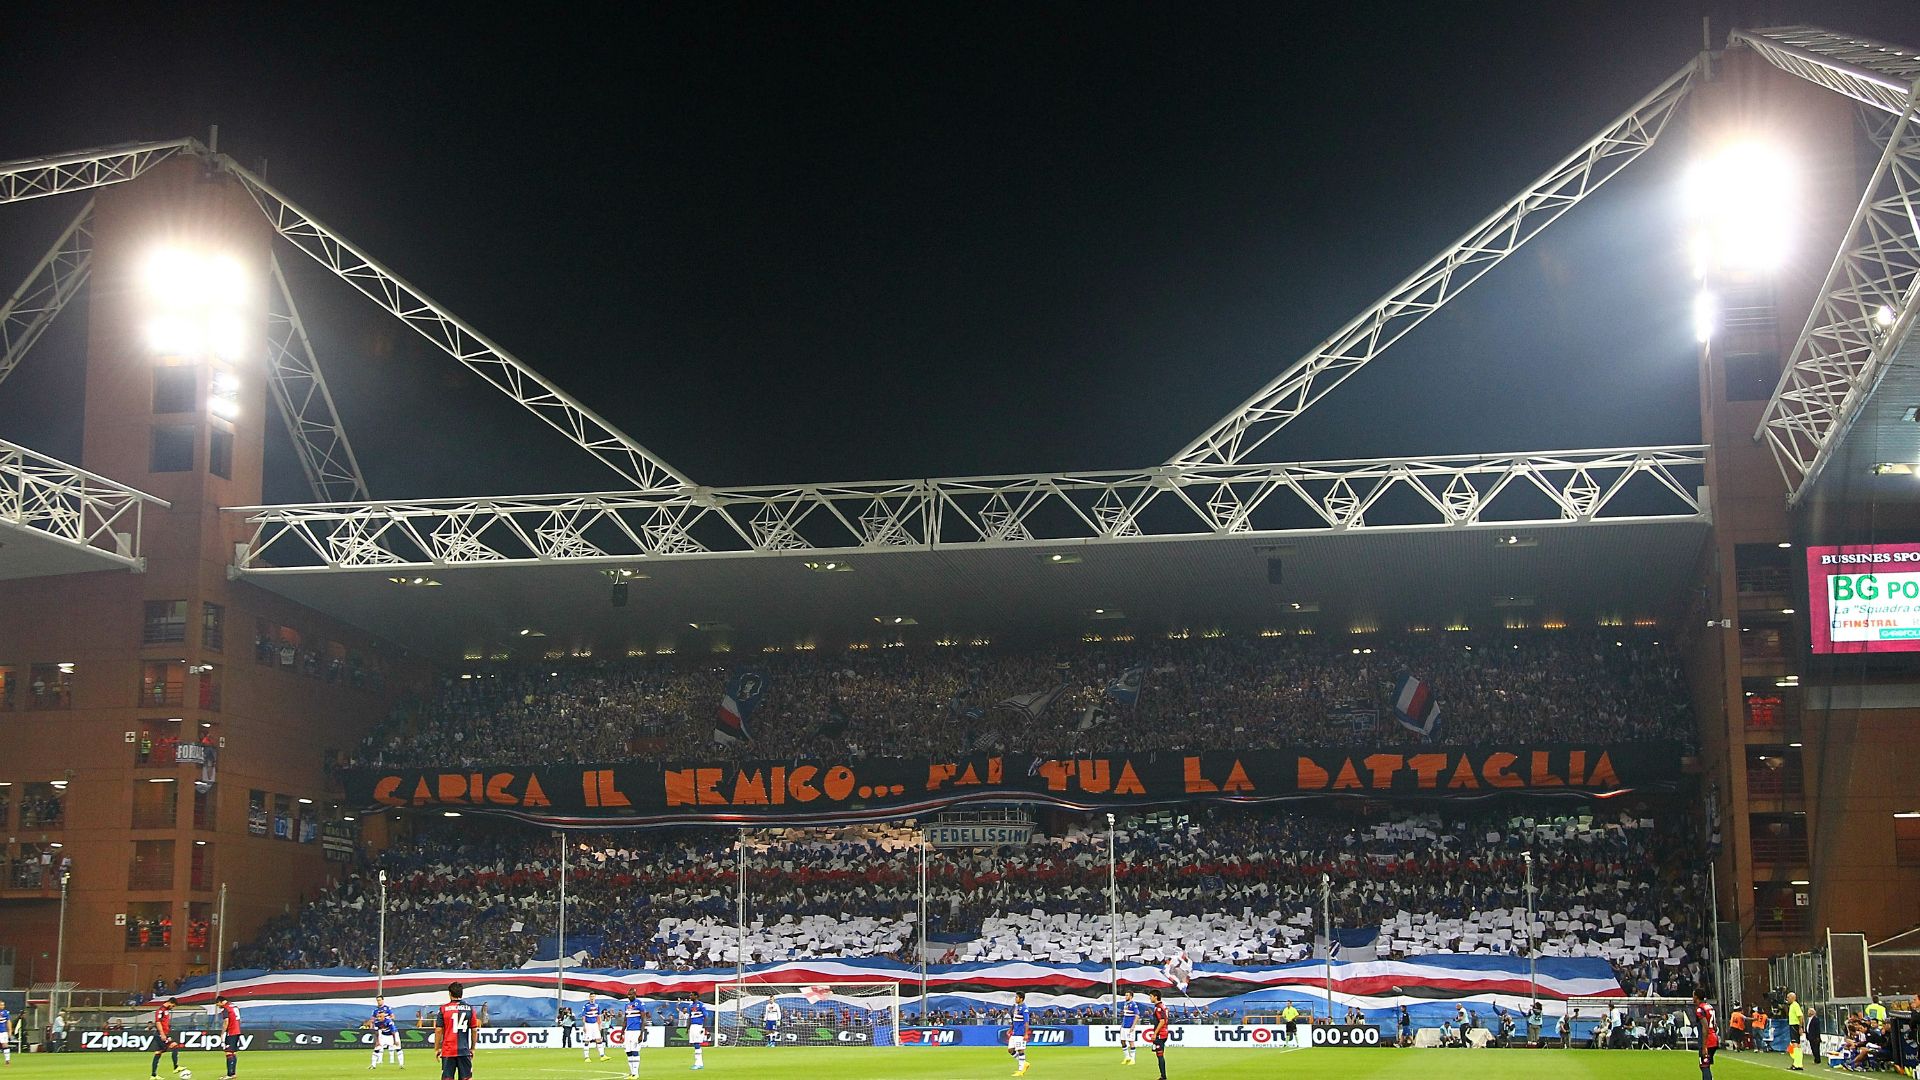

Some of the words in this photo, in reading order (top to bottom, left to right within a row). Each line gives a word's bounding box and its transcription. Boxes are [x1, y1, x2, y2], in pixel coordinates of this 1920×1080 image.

[1821, 553, 1891, 564] BUSSINES
[1833, 574, 1879, 601] BG
[1887, 581, 1919, 599] PO
[1843, 619, 1899, 628] FINSTRAL
[583, 770, 632, 806] IL
[1038, 759, 1147, 794] TUA
[1184, 756, 1256, 793] LA
[1298, 751, 1621, 789] BATTAGLIA
[930, 828, 1029, 843] FEDELISSIMI
[451, 1012, 468, 1033] 14
[476, 1028, 549, 1045] infront
[922, 1030, 955, 1043] TM
[1032, 1030, 1066, 1043] TIM
[1312, 1027, 1379, 1045] 00:00
